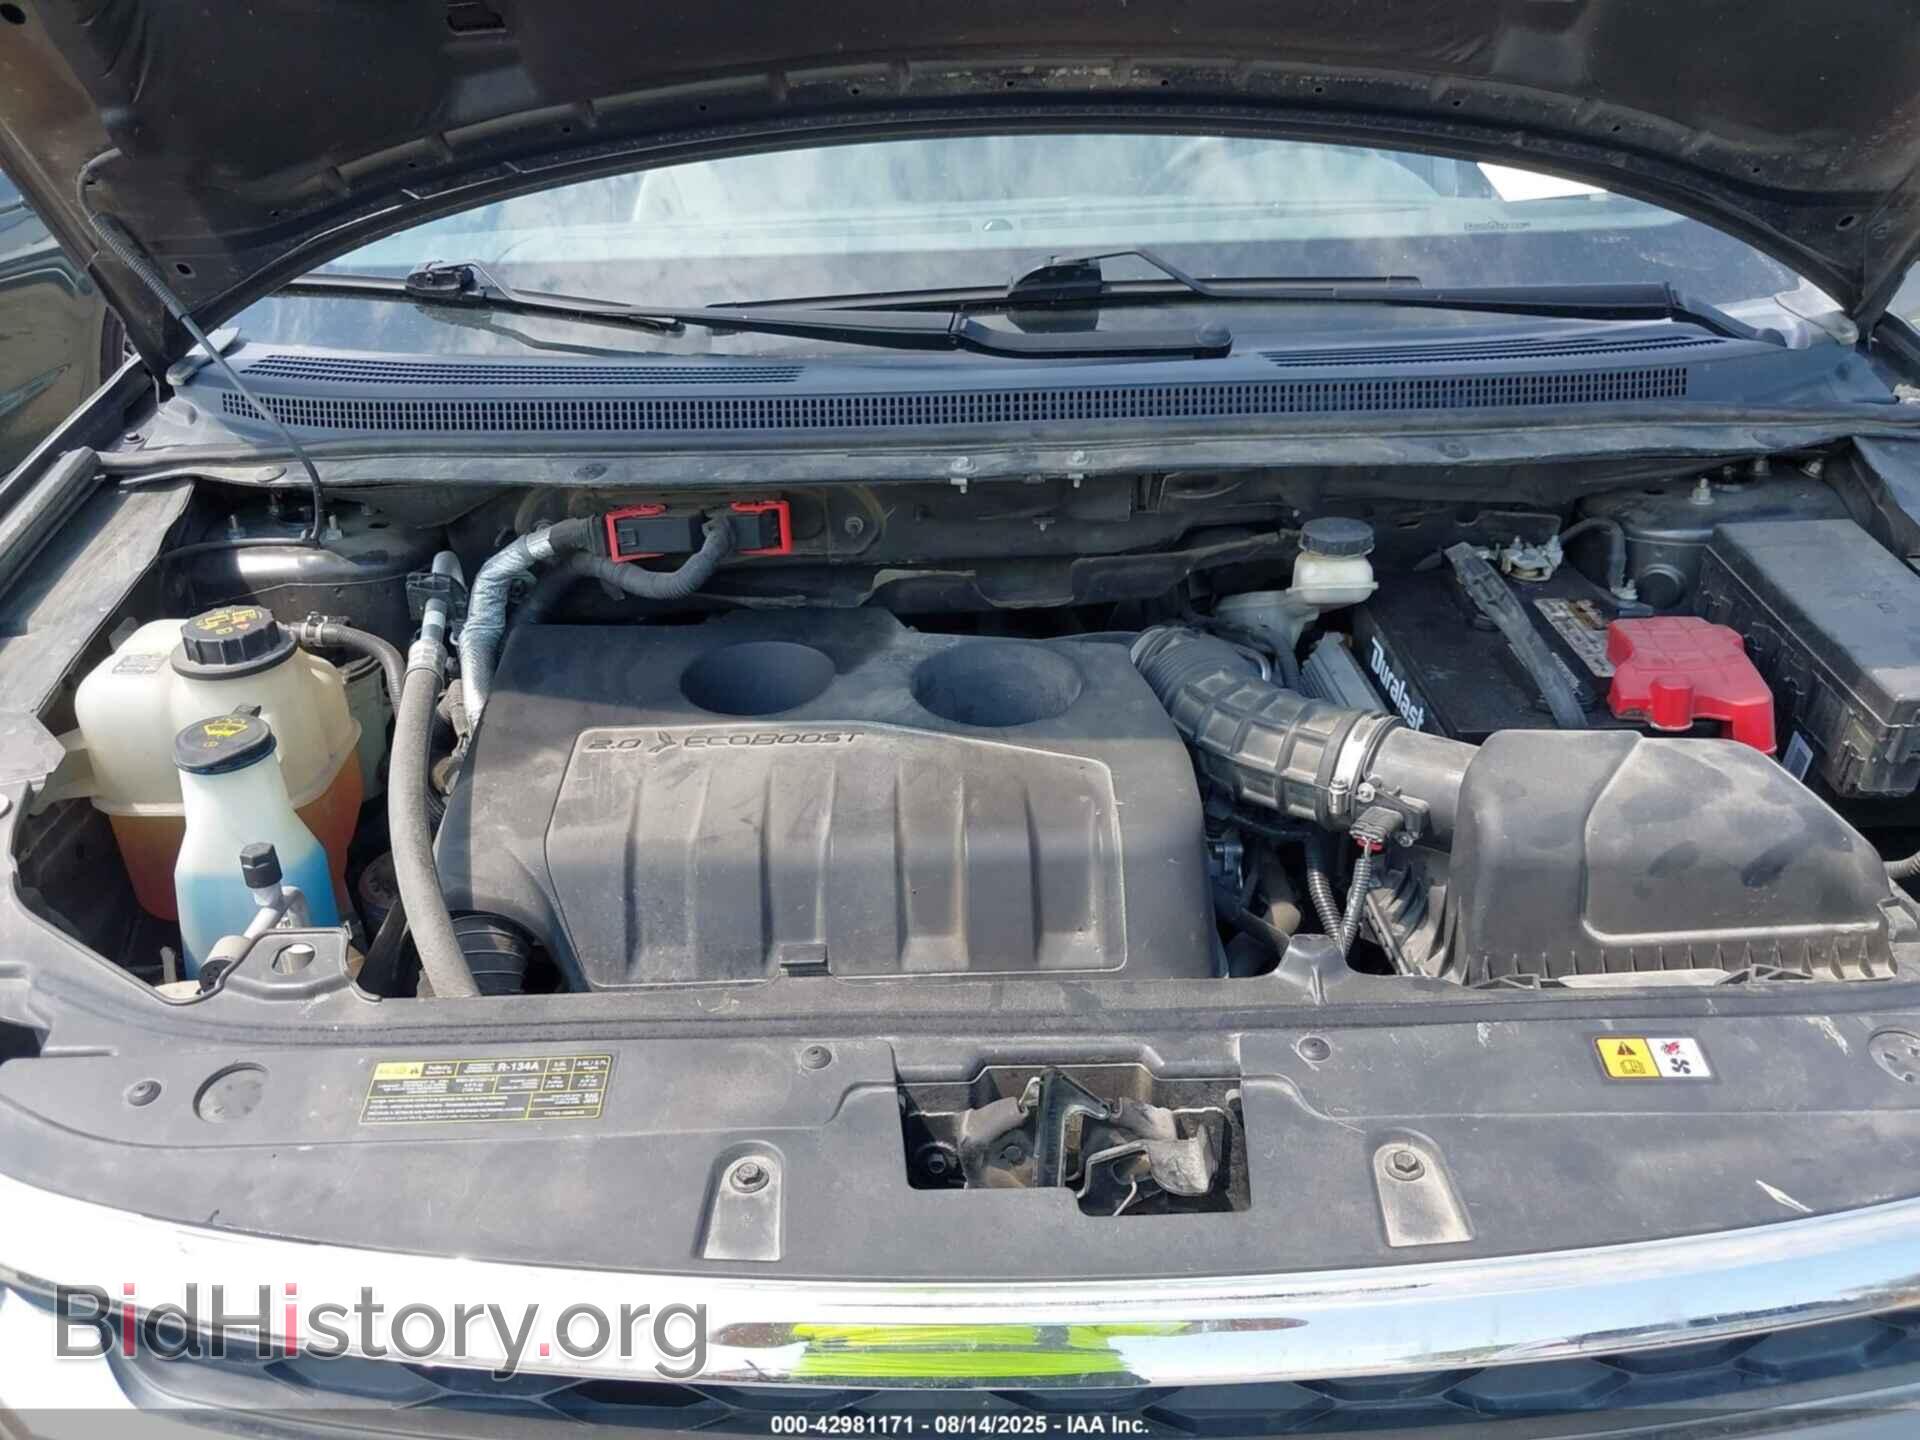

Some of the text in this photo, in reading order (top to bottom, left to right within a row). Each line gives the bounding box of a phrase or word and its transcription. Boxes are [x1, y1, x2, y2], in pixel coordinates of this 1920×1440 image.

[1371, 635, 1424, 731] Duralast
[587, 732, 864, 749] 2.0 ECOBOOST
[497, 1061, 539, 1072] R-134A
